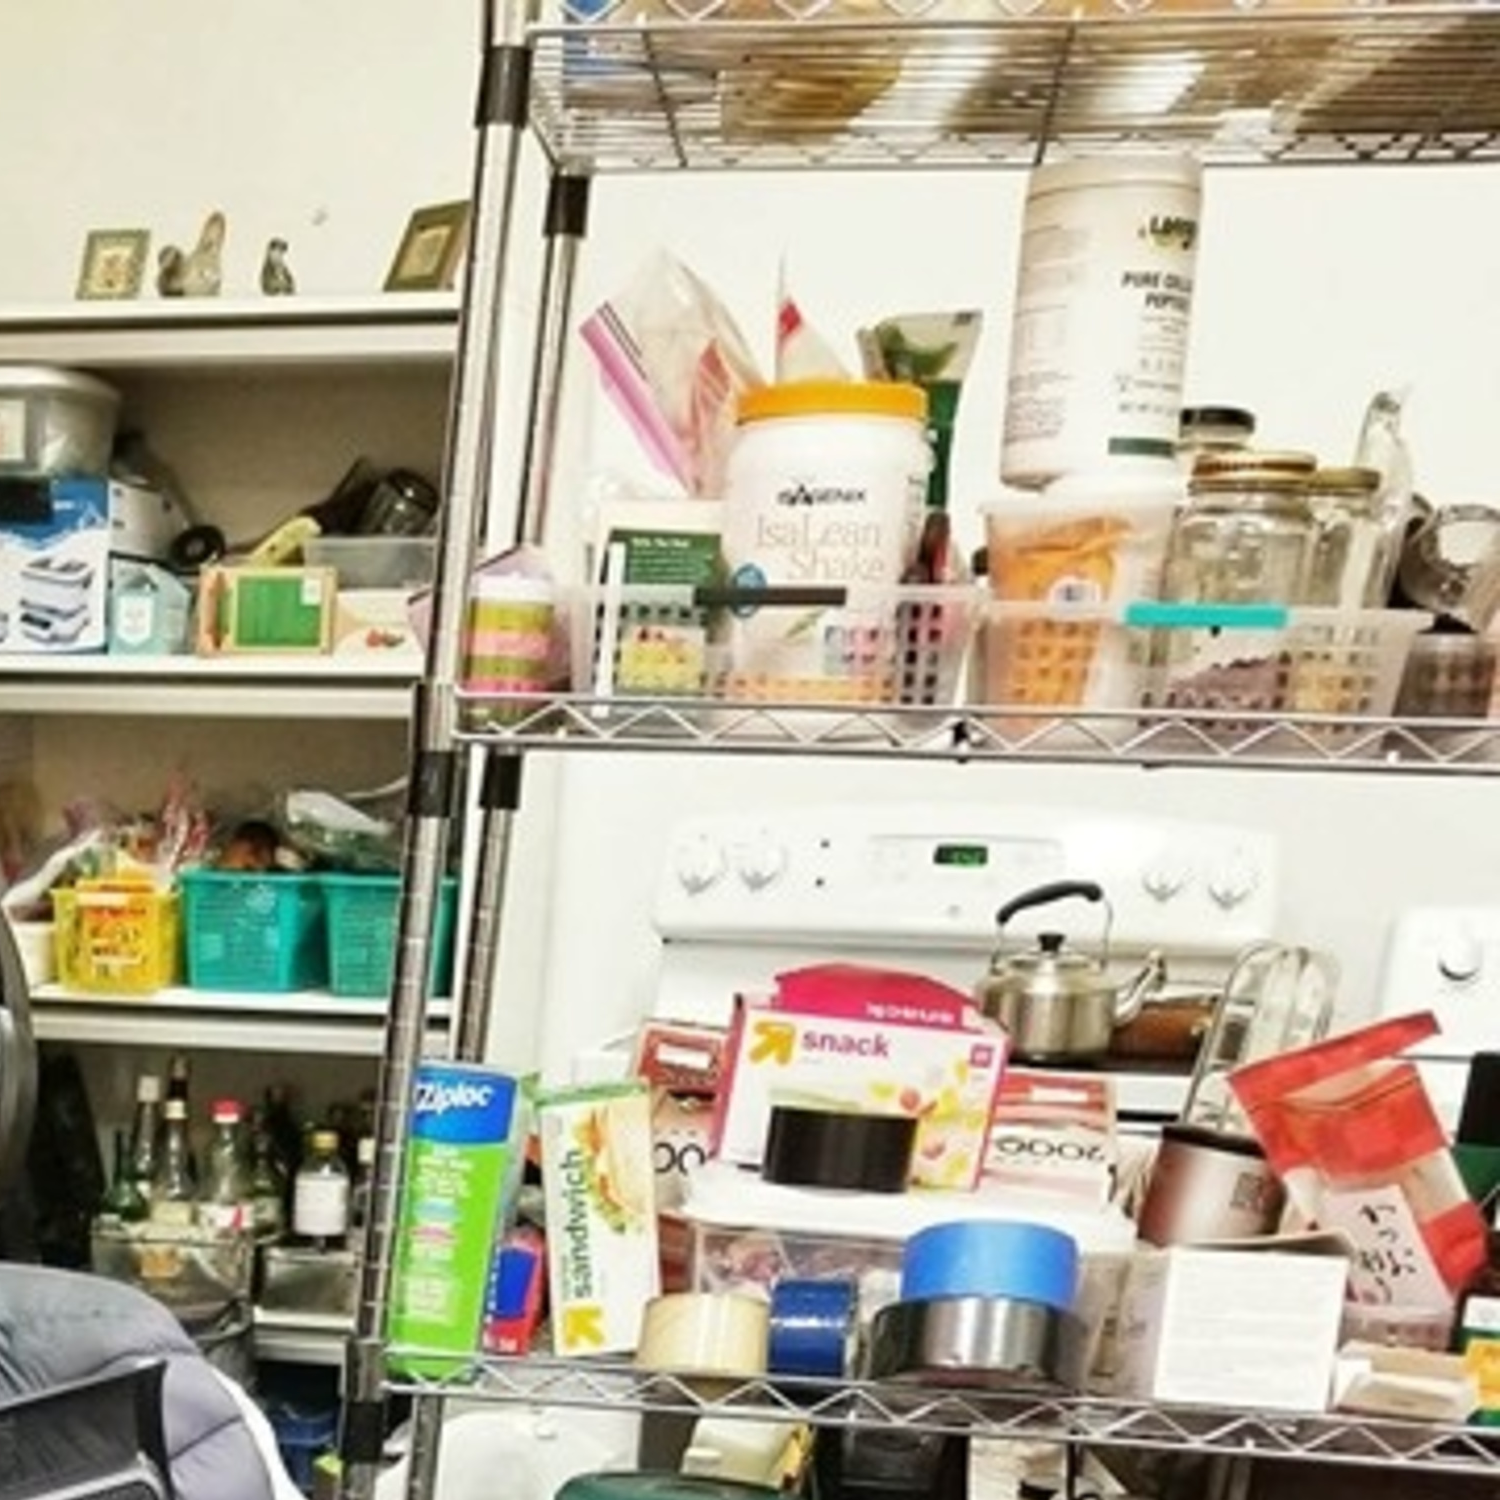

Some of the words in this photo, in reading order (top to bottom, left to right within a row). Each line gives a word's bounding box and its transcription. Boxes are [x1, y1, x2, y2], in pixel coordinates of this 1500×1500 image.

[802, 1028, 890, 1059] snack
[414, 1081, 494, 1116] Ziploc
[559, 1150, 593, 1299] sandwich
